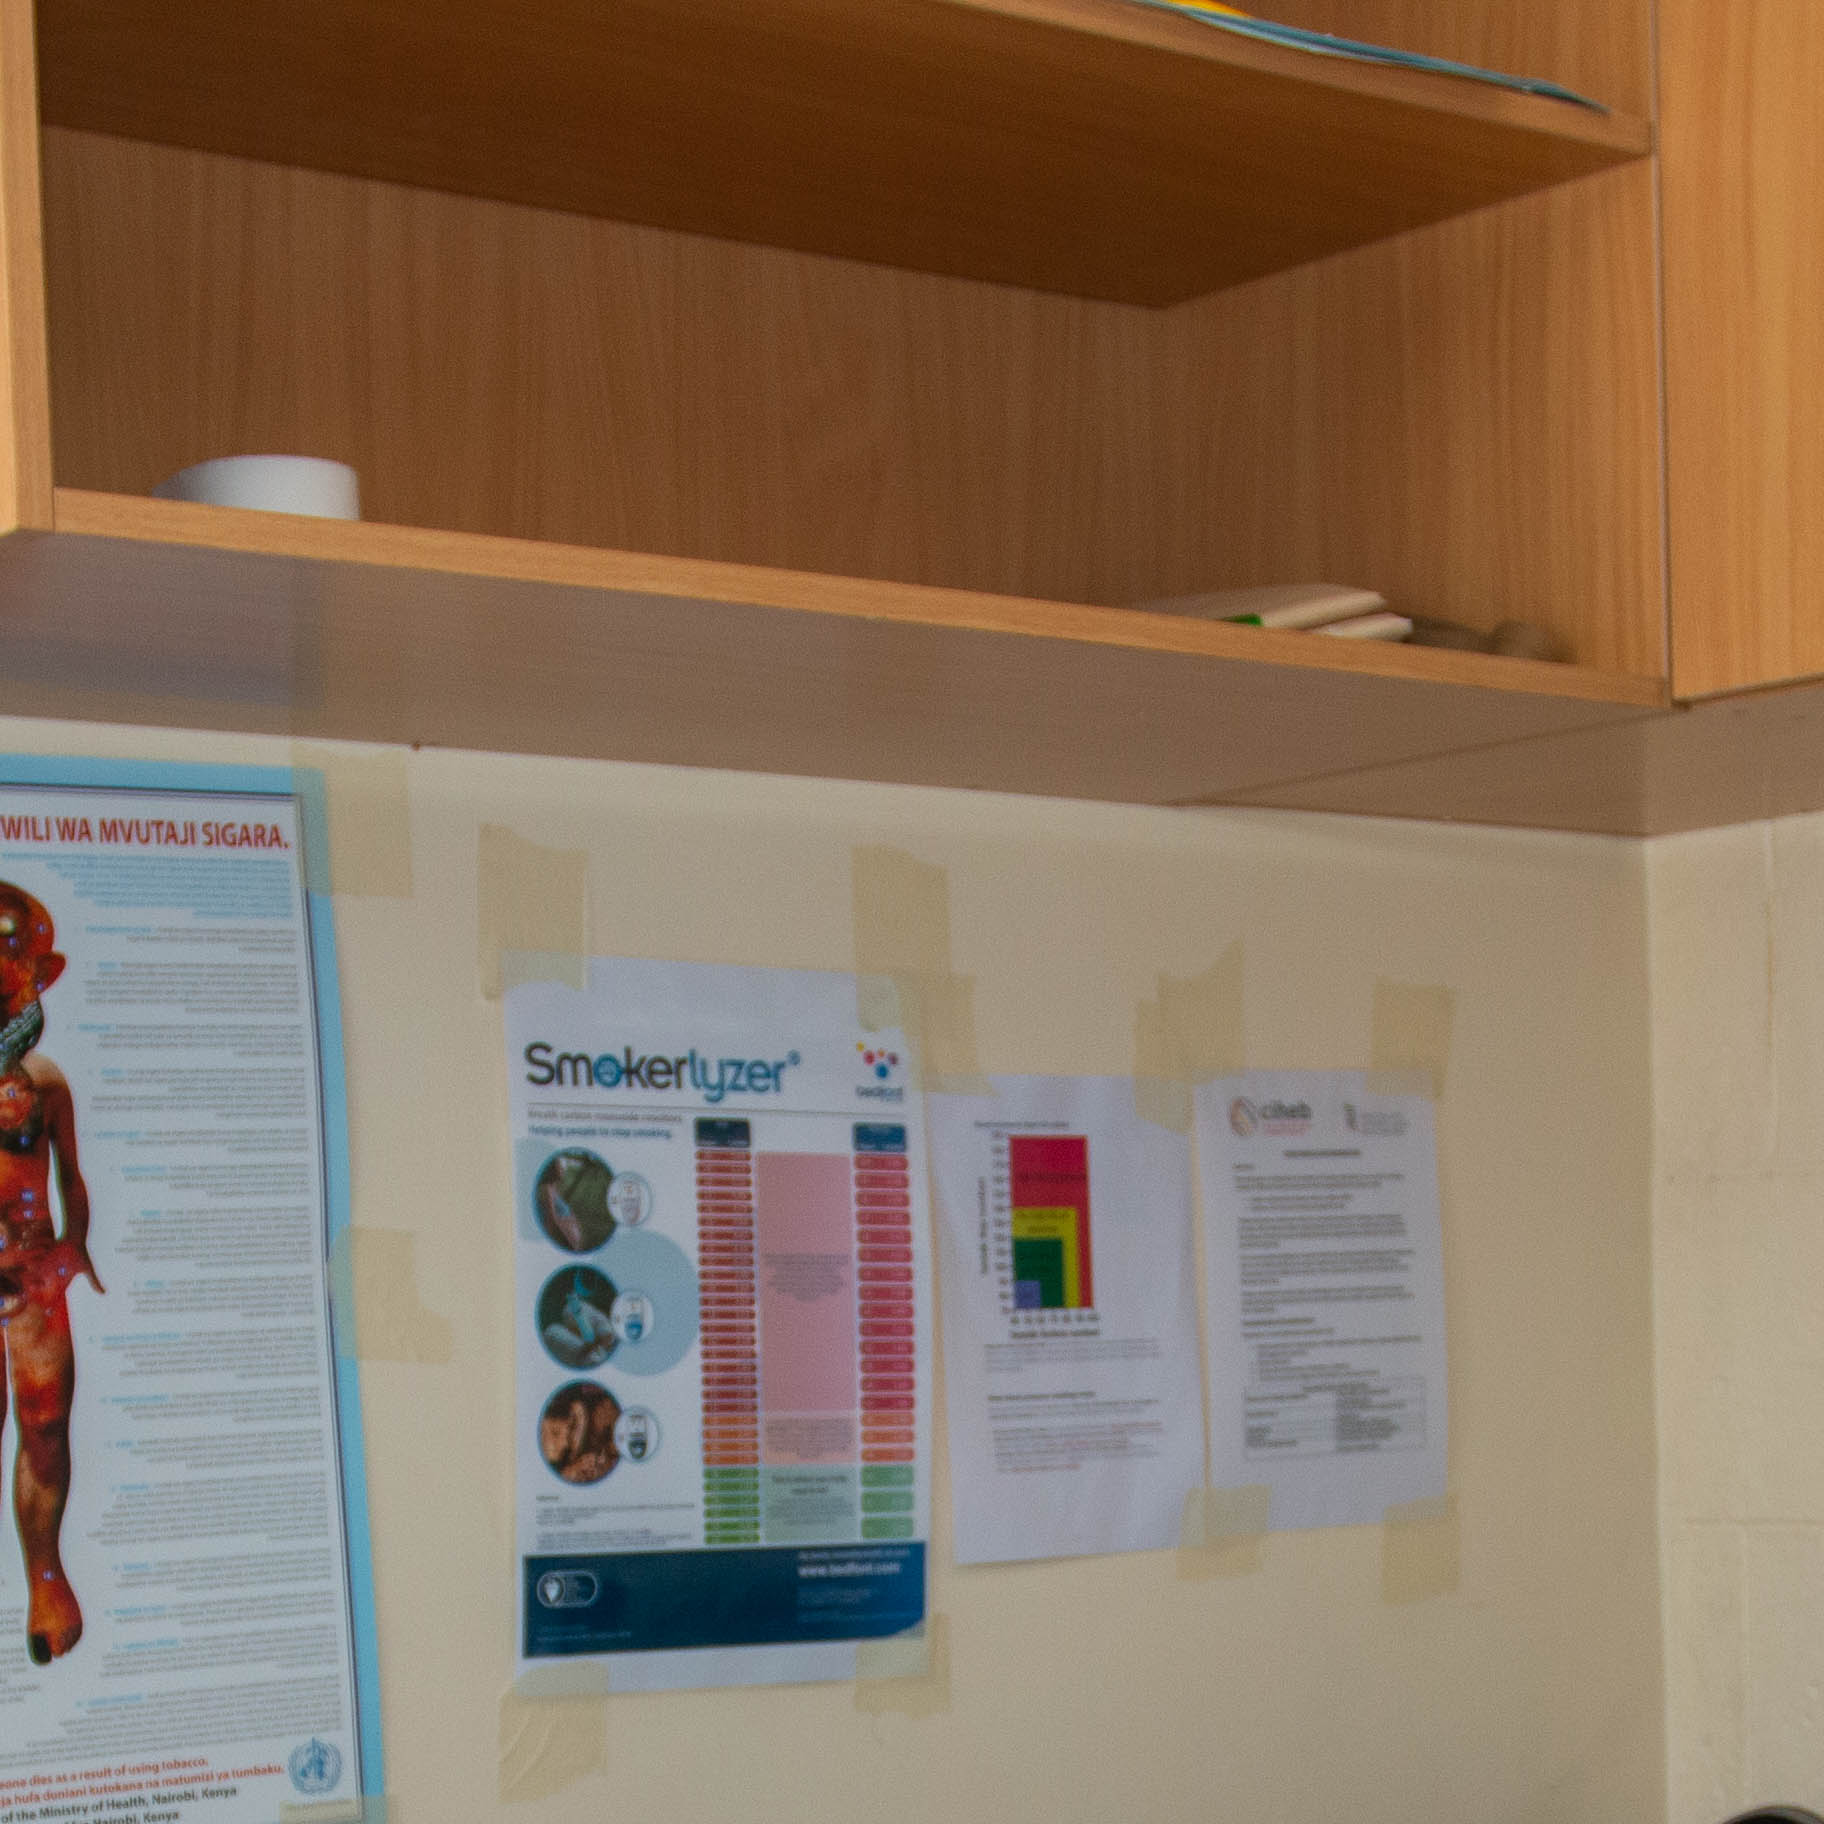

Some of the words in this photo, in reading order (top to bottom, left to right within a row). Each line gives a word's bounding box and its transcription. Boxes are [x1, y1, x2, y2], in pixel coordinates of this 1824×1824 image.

[55, 816, 93, 842] WA
[100, 818, 196, 845] MVUTAJI
[202, 821, 289, 849] SIGARA.
[29, 1773, 52, 1786] dies
[56, 1773, 67, 1783] as
[70, 1772, 77, 1781] a
[80, 1766, 112, 1780] result
[114, 1764, 126, 1775] of
[128, 1760, 159, 1776] using
[162, 1754, 208, 1770] tobacco.
[0, 1811, 13, 1824] of
[16, 1808, 36, 1822] the
[39, 1802, 88, 1820] Ministry
[91, 1800, 102, 1812] of
[106, 1795, 147, 1812] Health,
[151, 1788, 197, 1806] Nairobi,
[201, 1784, 236, 1800] Kenya
[142, 1809, 178, 1824] Kenya
